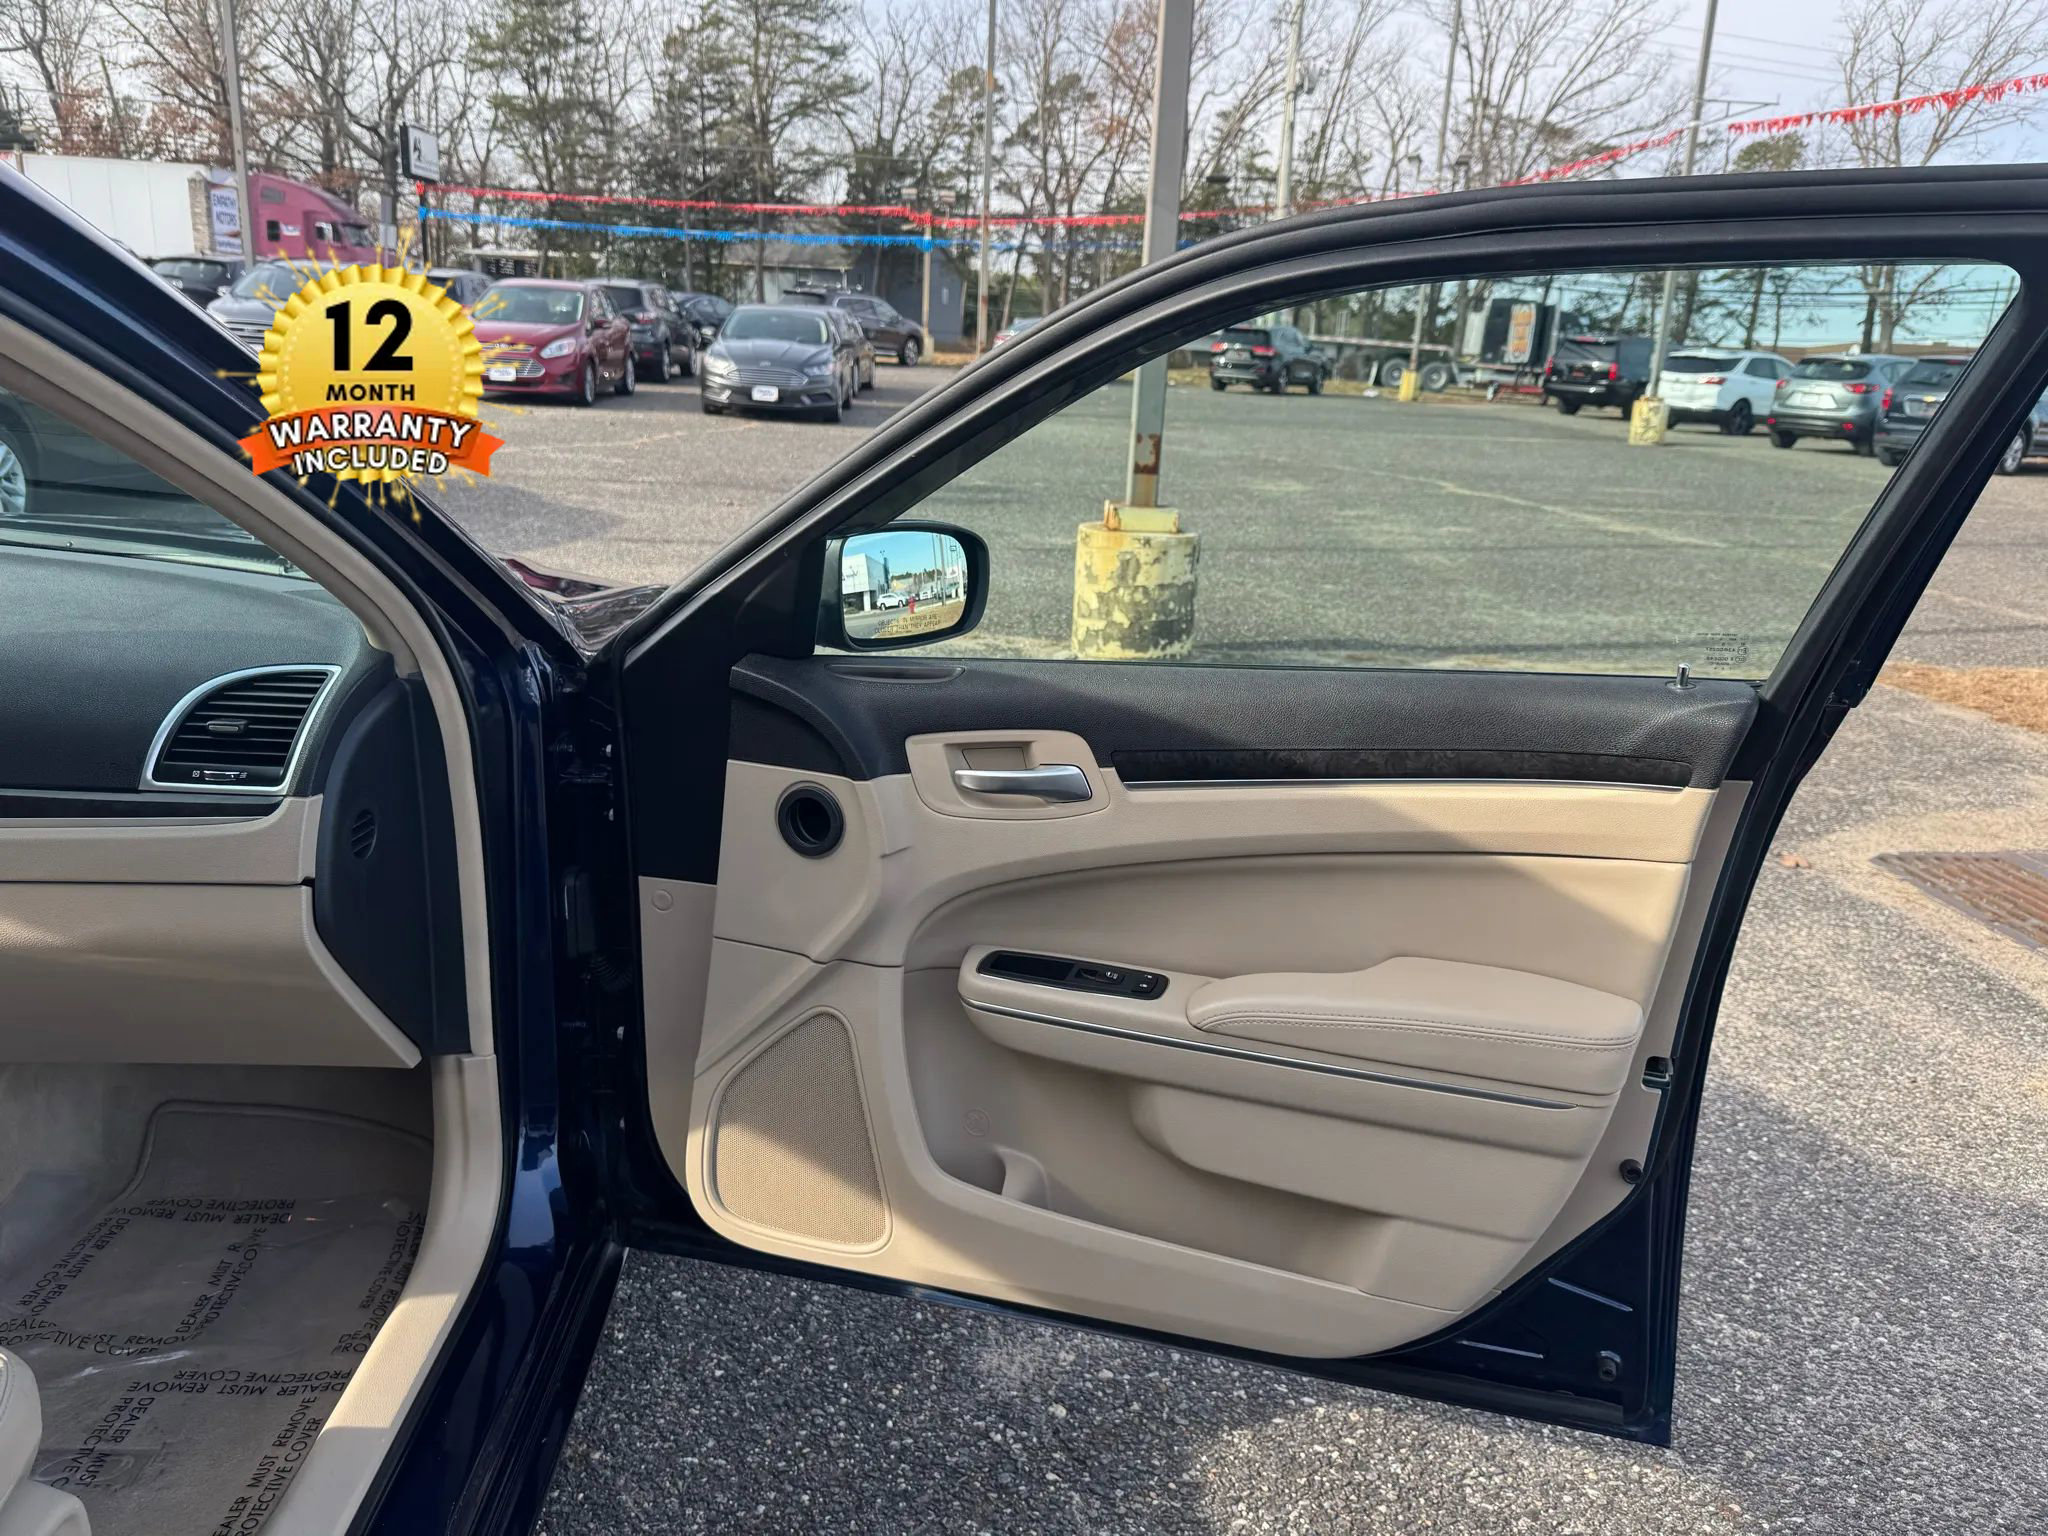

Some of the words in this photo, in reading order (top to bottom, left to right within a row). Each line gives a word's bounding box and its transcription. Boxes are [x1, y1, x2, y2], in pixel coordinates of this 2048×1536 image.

[183, 1210, 227, 1224] MUST
[233, 1213, 292, 1225] DEALER
[64, 1253, 95, 1279] MUST
[16, 1271, 59, 1306] COVER
[173, 1369, 240, 1381] COVER
[244, 1368, 352, 1384] PROTECTIVE
[127, 1381, 209, 1394] REMOVE
[216, 1384, 268, 1396] MUST
[276, 1382, 347, 1396] DEALER
[111, 1397, 155, 1443] DEALER
[62, 1397, 134, 1473] PROTECTIVE
[75, 1453, 112, 1487] MUST
[212, 1495, 252, 1536] EALER
[246, 1455, 279, 1488] MUST
[272, 1396, 317, 1447] REMOVE
[234, 1465, 293, 1536] ROTECTIVE
[284, 1417, 323, 1462] COVER
